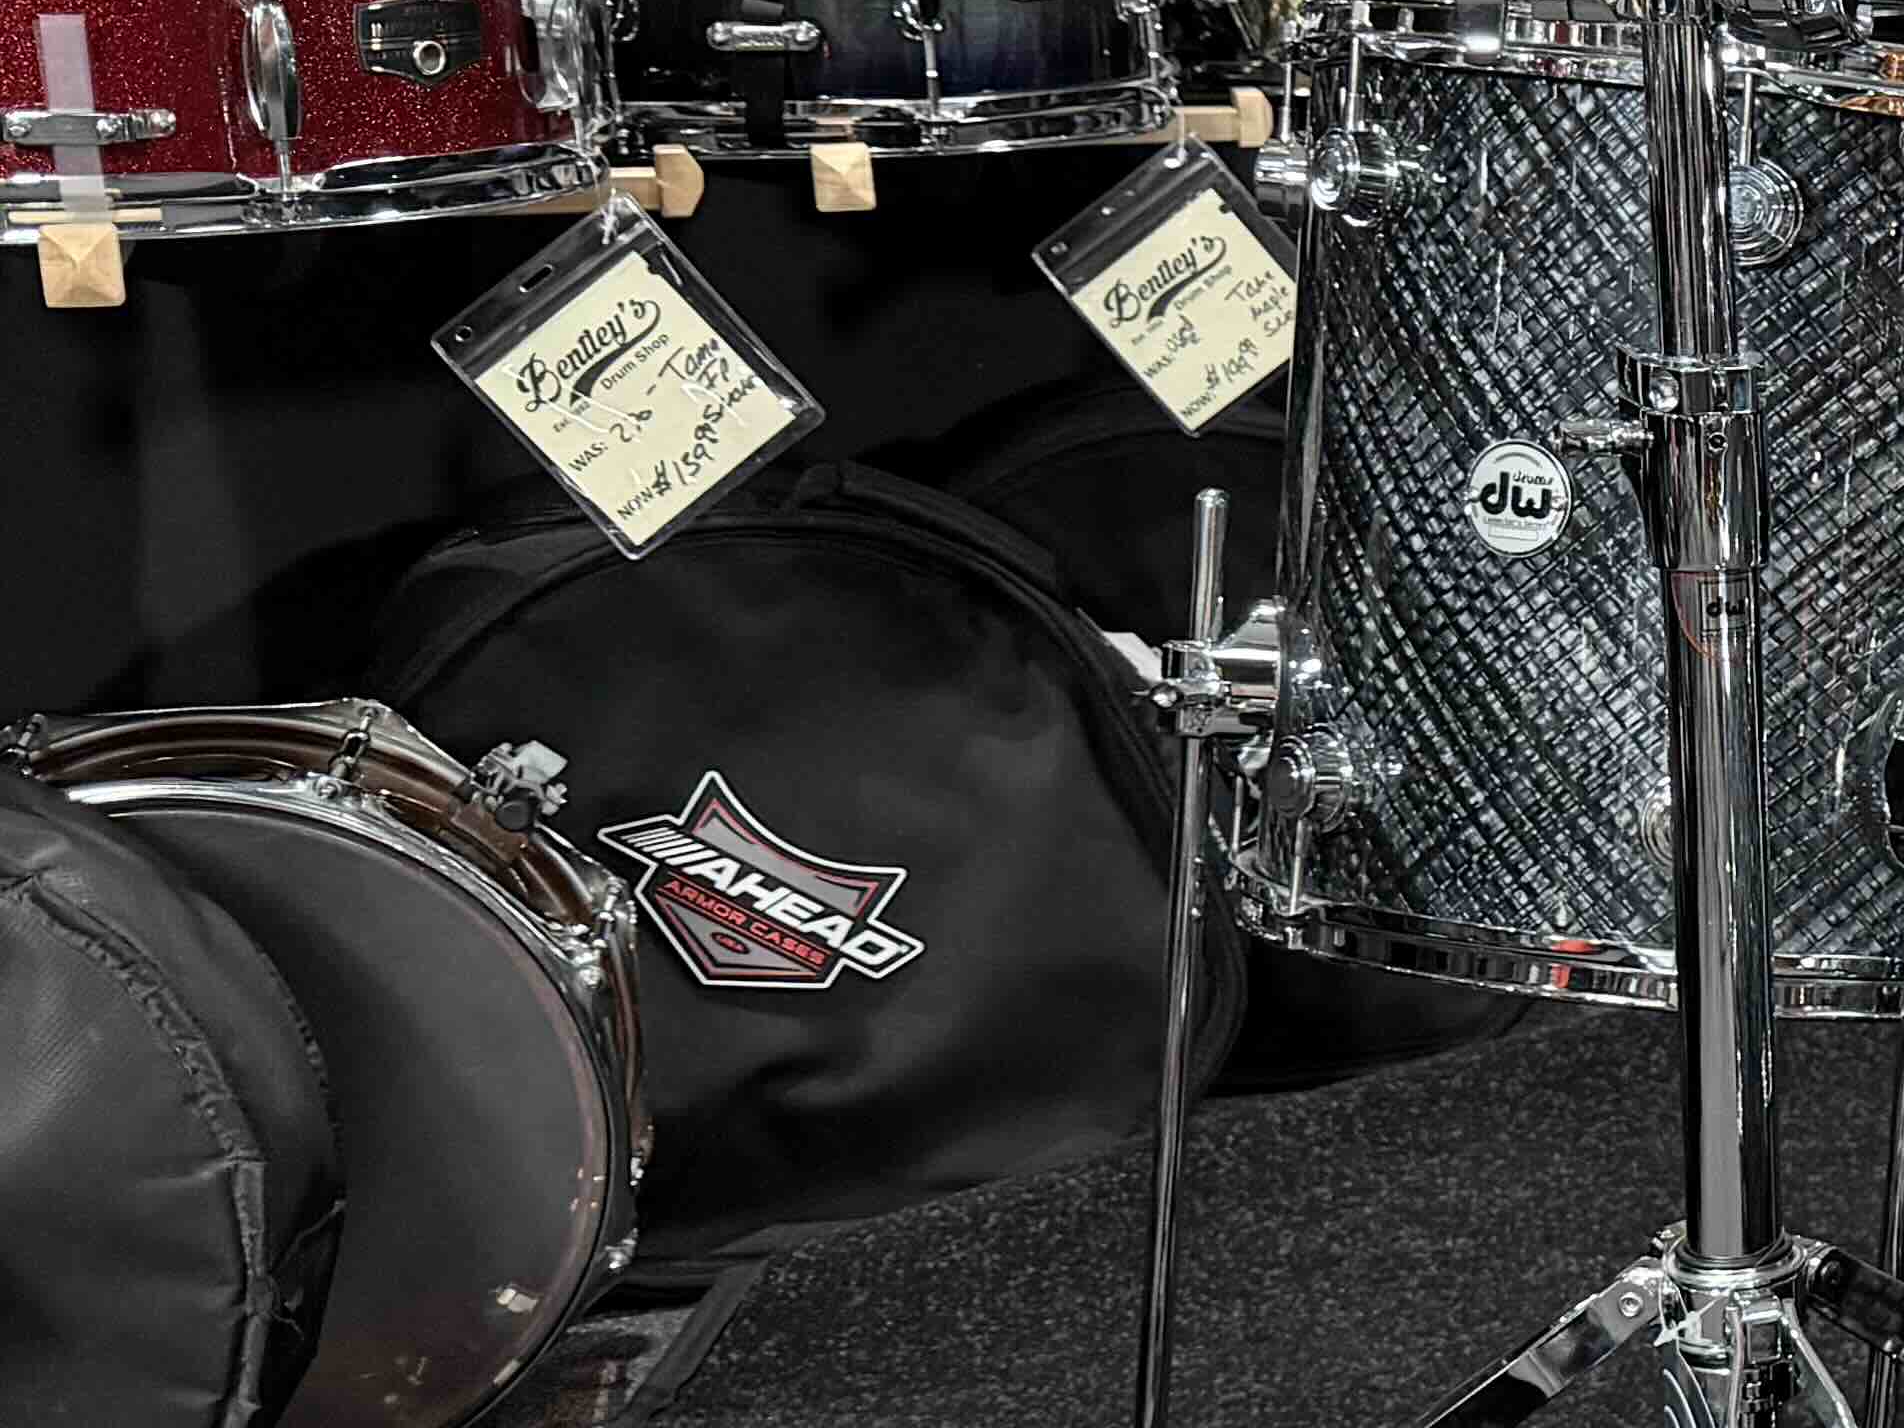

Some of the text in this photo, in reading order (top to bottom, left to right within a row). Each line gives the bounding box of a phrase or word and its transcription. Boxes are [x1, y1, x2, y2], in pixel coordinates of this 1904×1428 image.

[1104, 235, 1216, 329] Bentley's
[517, 298, 648, 414] Bentley's
[600, 332, 671, 393] Drum Shop
[569, 440, 609, 473] WAS:
[1513, 471, 1554, 485] drums
[1481, 472, 1553, 519] dw
[1706, 596, 1746, 618] dw
[663, 880, 748, 925] ARMOR
[749, 921, 827, 966] CASES
[683, 857, 909, 966] AHEAD
